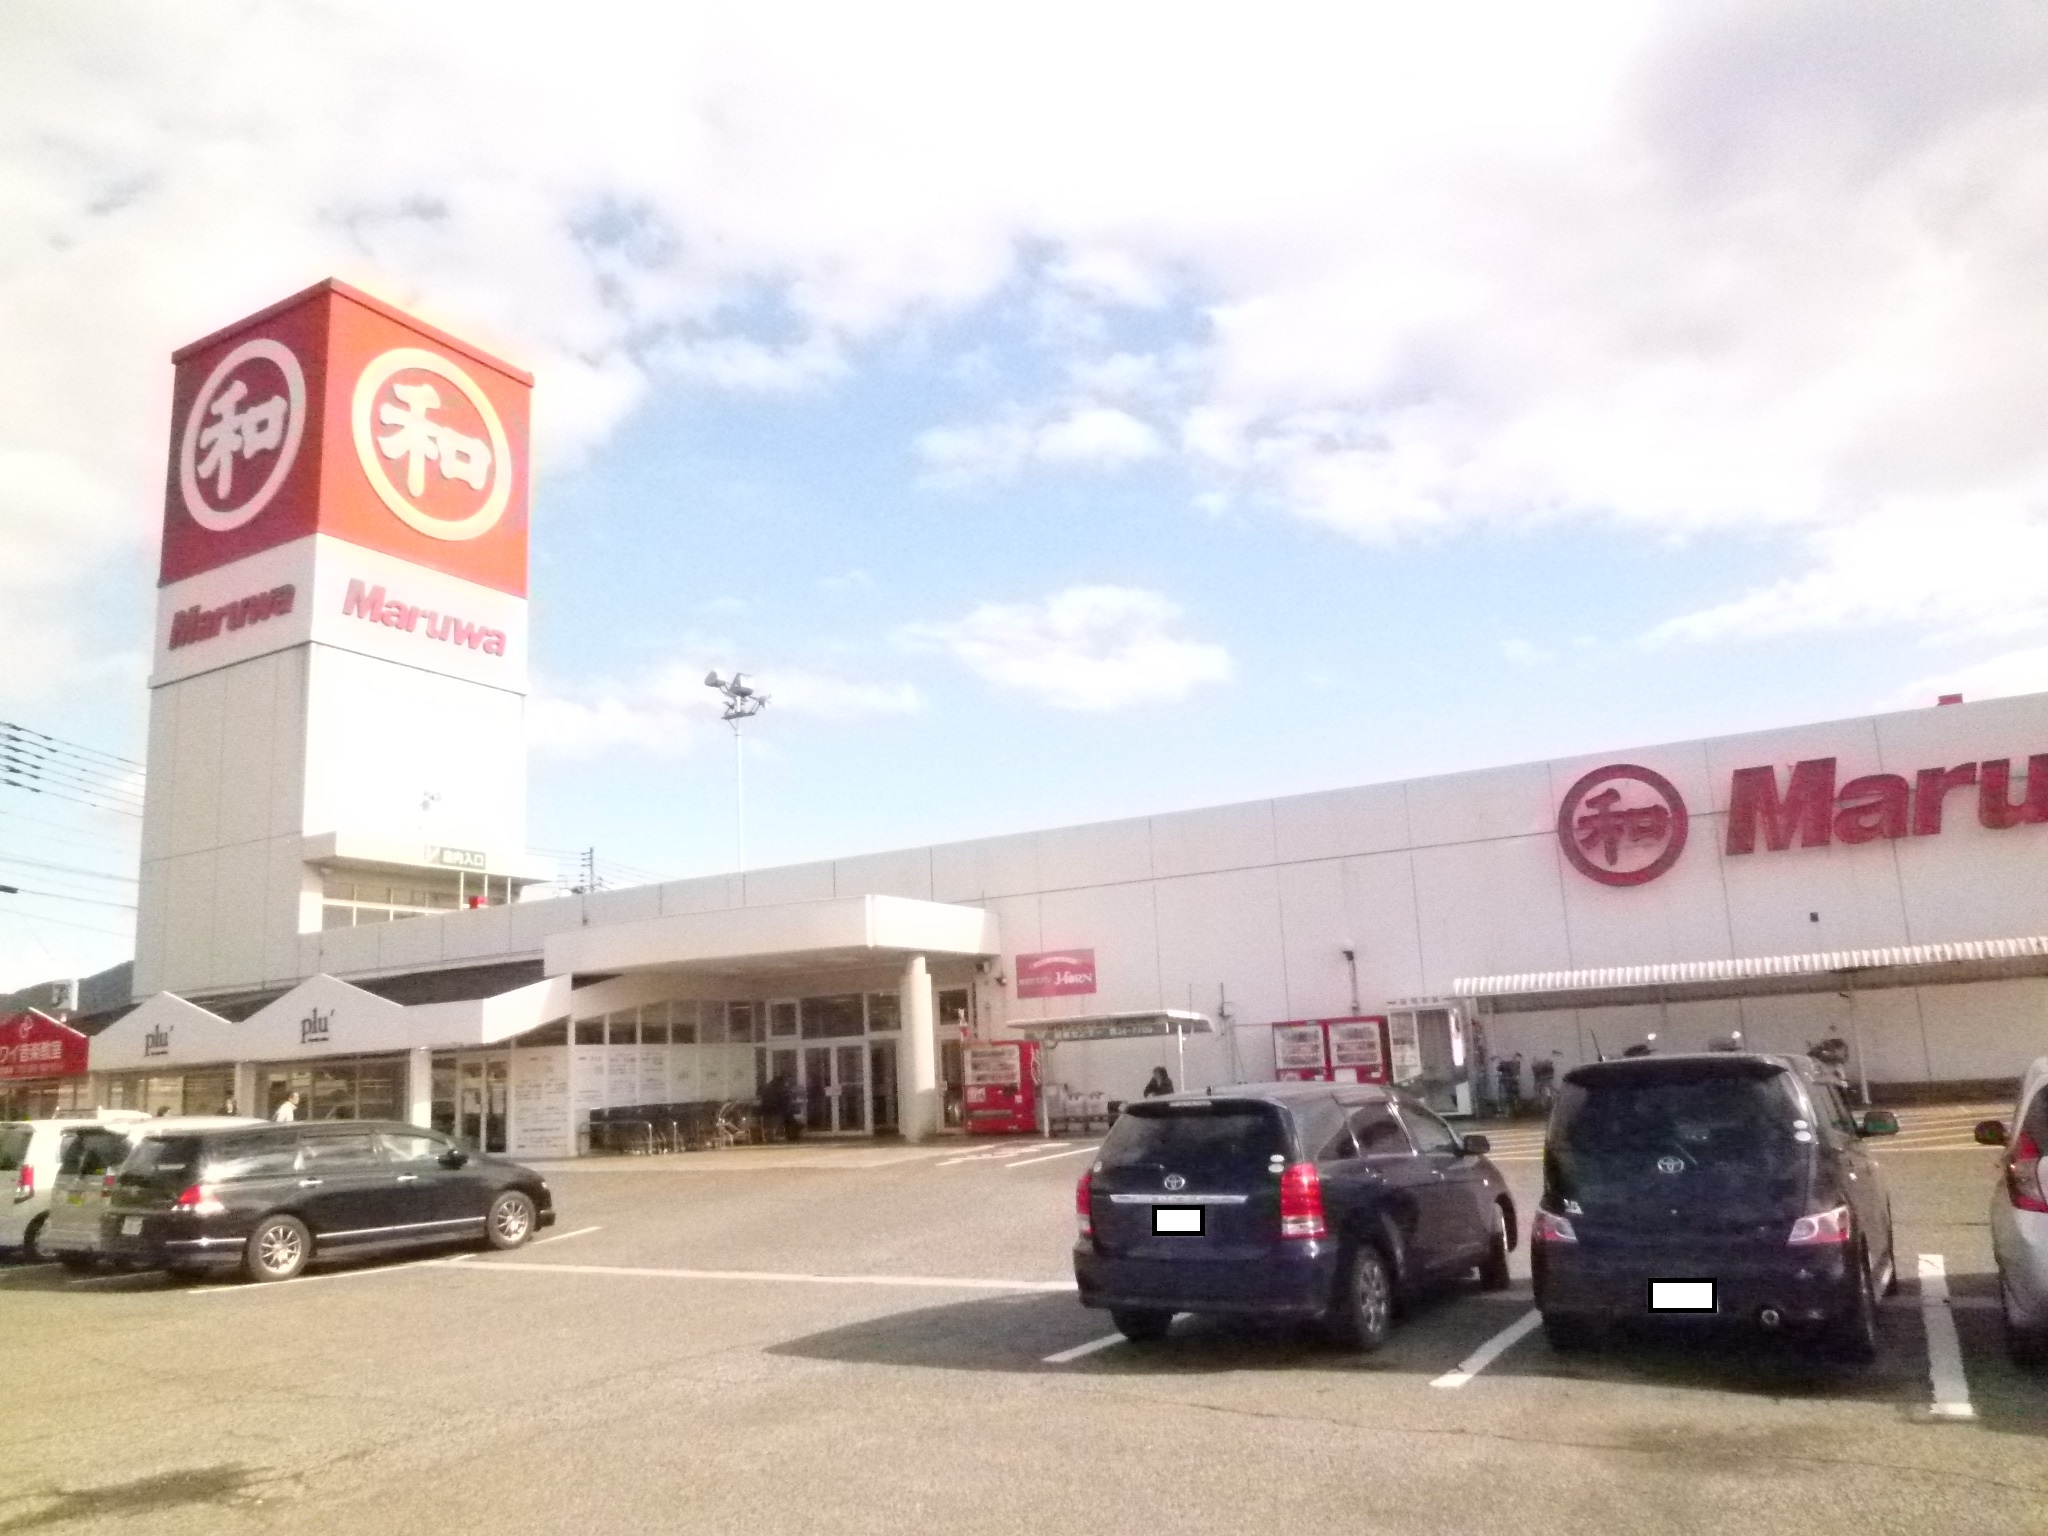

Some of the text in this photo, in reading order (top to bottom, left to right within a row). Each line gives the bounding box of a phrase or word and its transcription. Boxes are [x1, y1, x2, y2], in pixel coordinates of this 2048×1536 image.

[198, 380, 288, 500] 和
[377, 382, 493, 499] 和
[169, 582, 296, 650] Maruwa
[342, 577, 507, 658] Maruwa
[1577, 787, 1672, 866] 和
[1725, 755, 2048, 856] Maru
